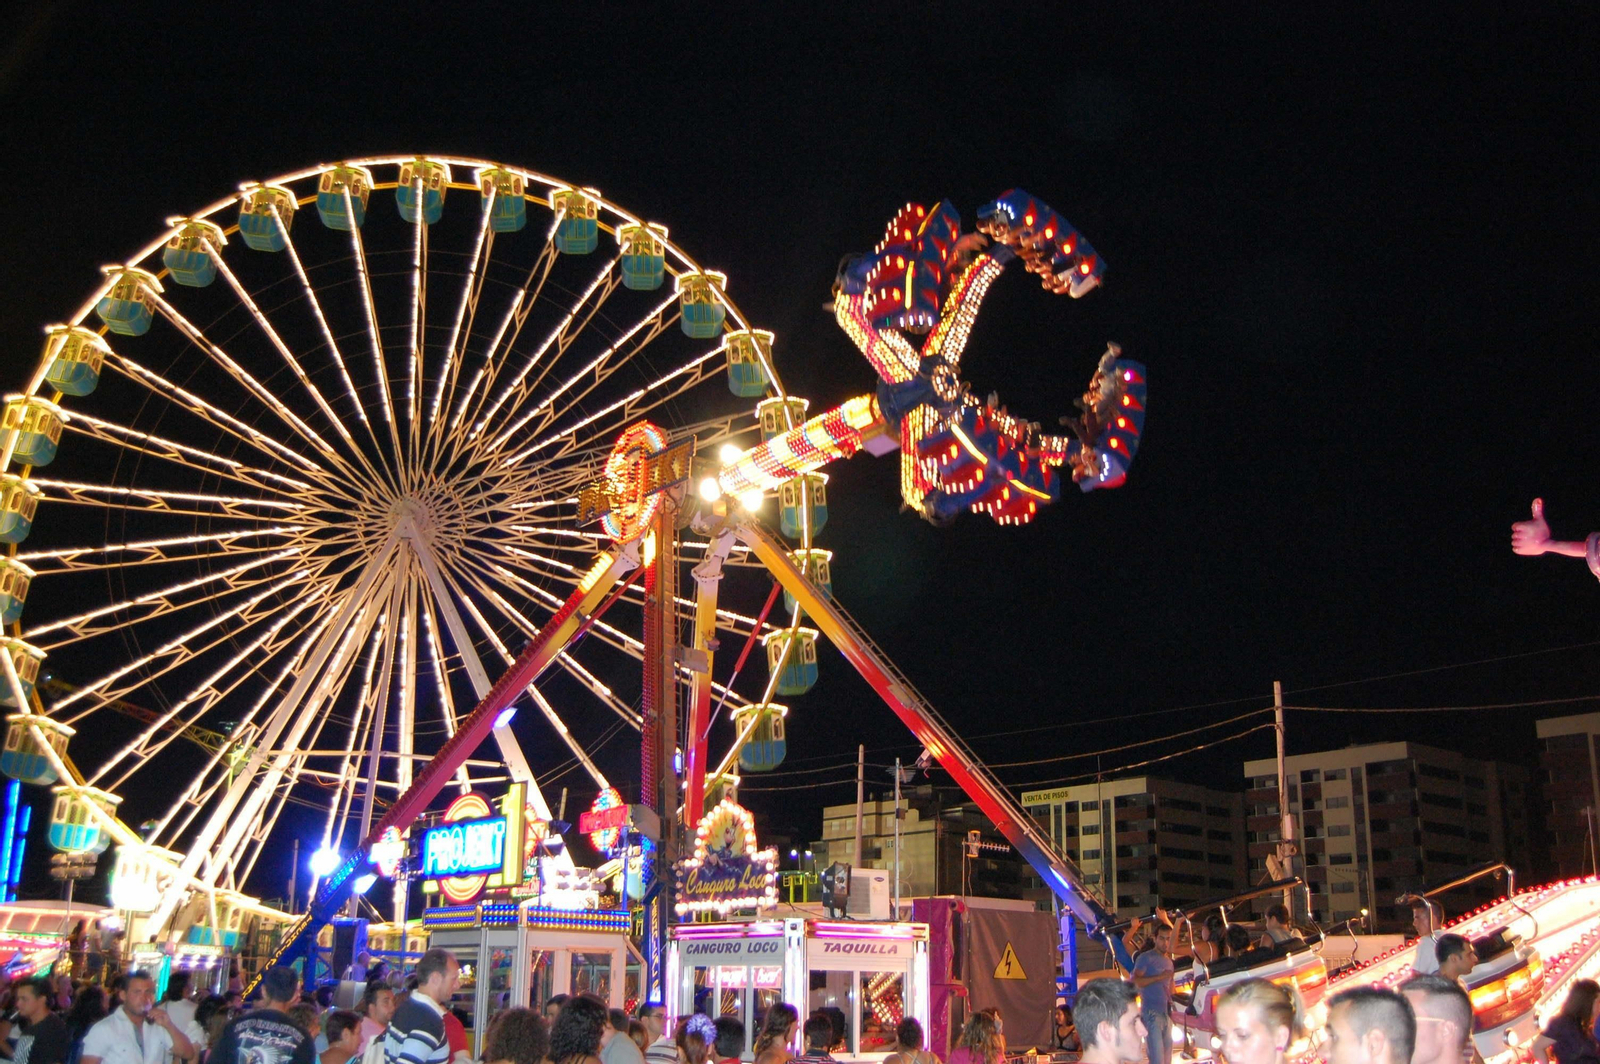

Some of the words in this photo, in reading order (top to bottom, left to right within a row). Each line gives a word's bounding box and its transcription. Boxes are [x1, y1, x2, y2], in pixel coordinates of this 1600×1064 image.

[1024, 794, 1042, 802] VENTA
[1052, 791, 1068, 799] PISOS
[686, 868, 736, 900] Canguro
[738, 864, 766, 890] Loco
[265, 914, 313, 970] TECHNICAL
[686, 942, 741, 955] CANGURO
[747, 941, 779, 954] LOCO
[823, 942, 898, 954] TAQUILLA
